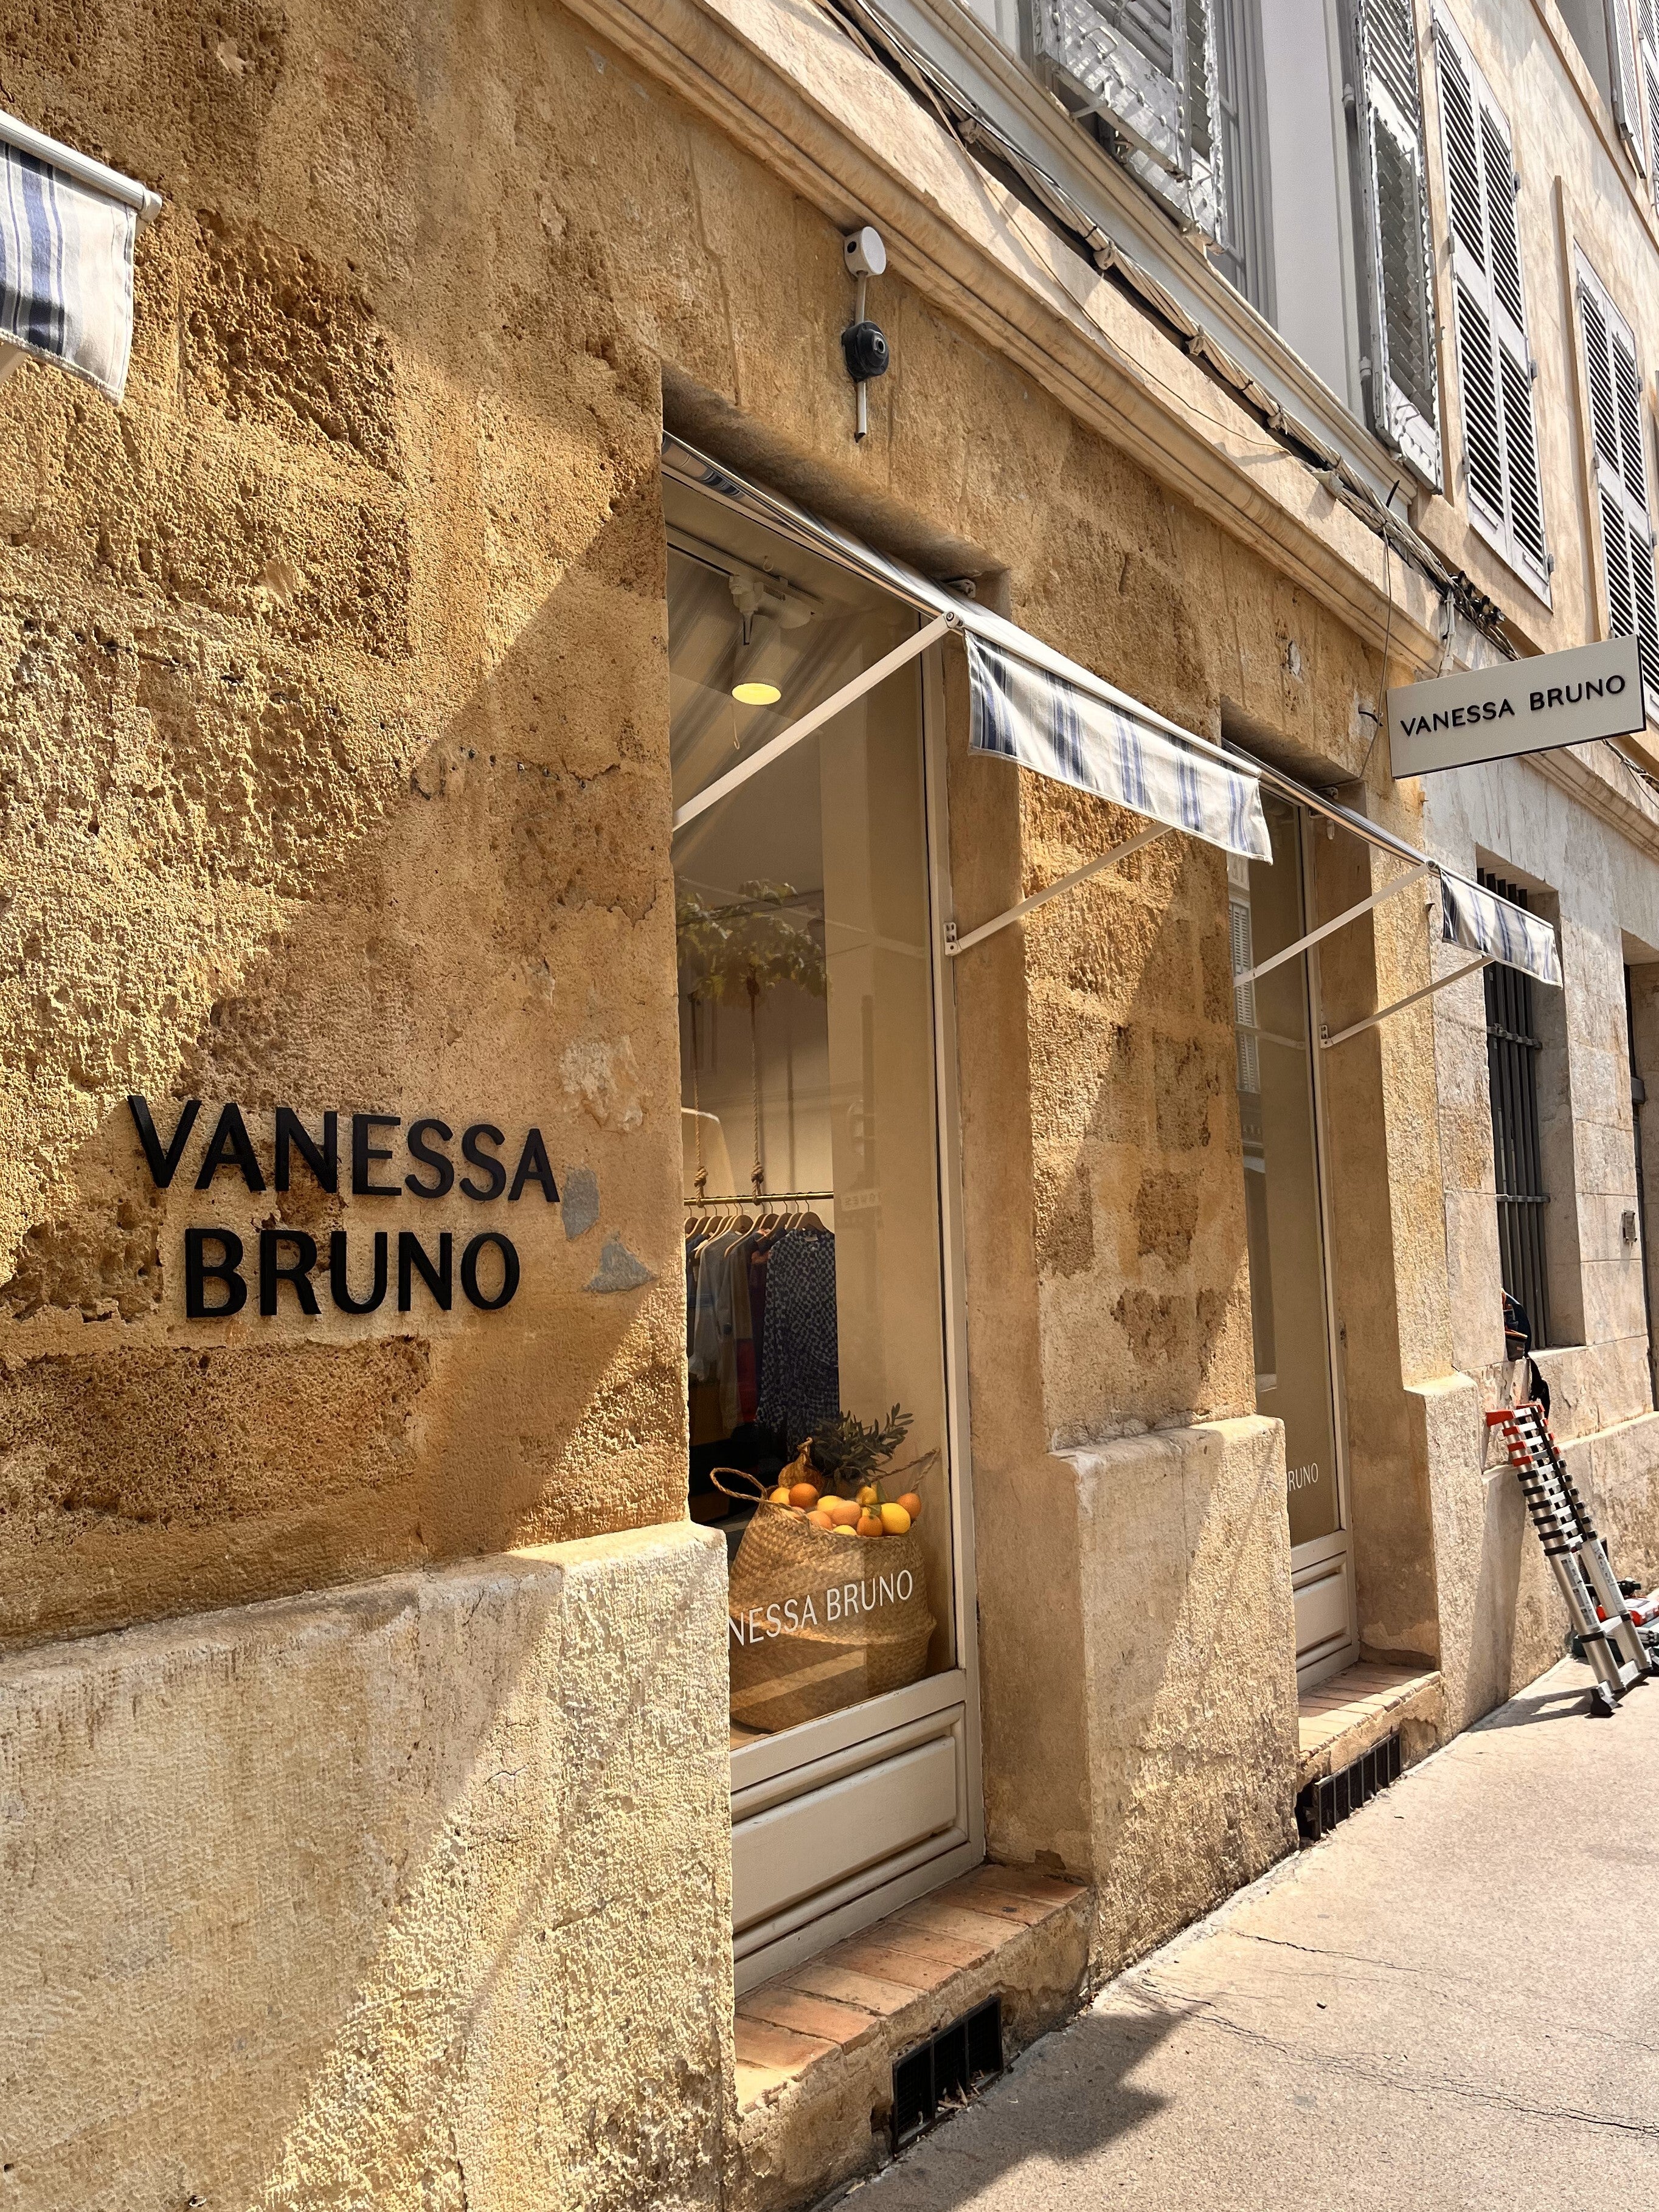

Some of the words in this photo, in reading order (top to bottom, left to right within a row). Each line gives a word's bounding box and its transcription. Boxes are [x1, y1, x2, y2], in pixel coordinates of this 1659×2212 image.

[1399, 698, 1515, 738] VANESSA
[1529, 675, 1626, 711] BRUNO
[126, 1094, 561, 1203] VANESSA
[184, 1227, 521, 1319] BRUNO
[826, 1569, 913, 1622] BRUNO
